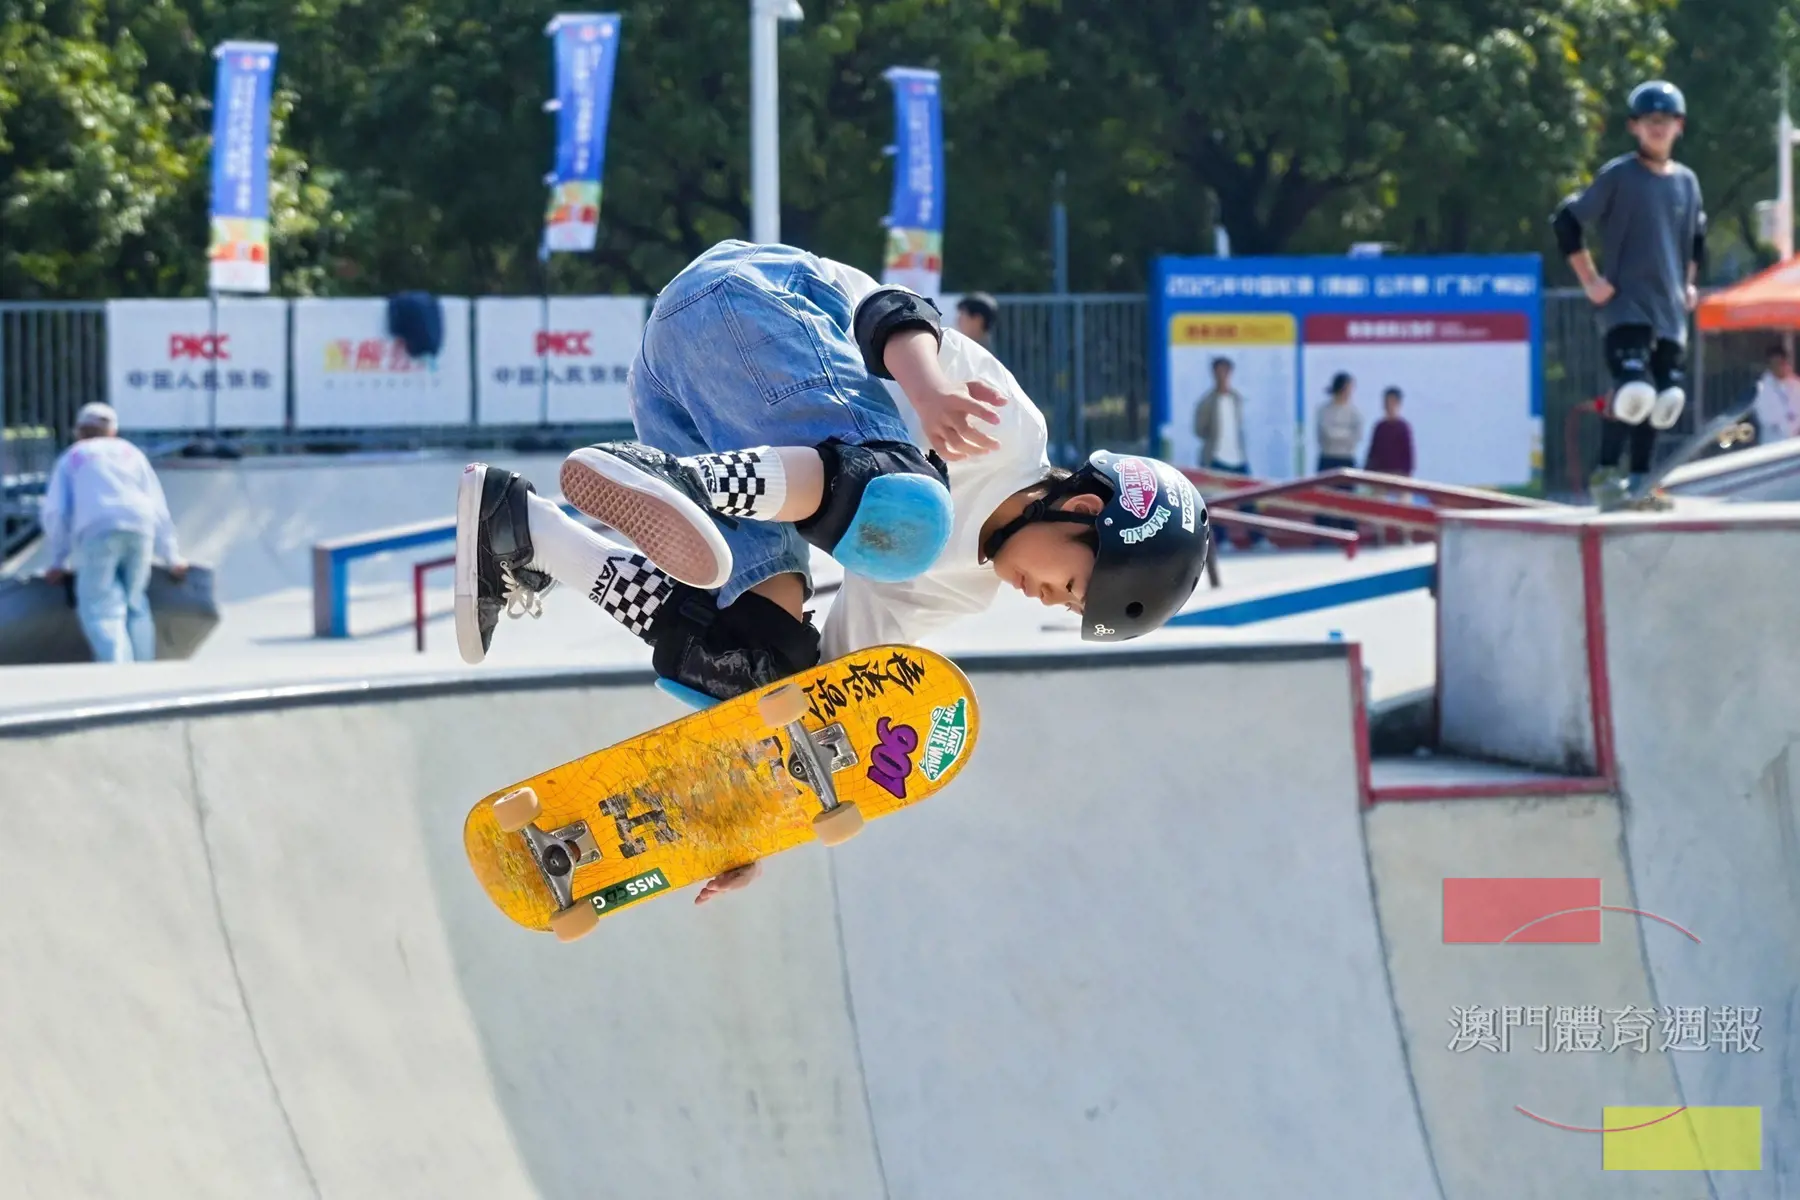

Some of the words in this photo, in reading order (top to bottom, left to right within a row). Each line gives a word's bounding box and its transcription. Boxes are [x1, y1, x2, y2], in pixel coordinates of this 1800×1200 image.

[1124, 471, 1141, 487] THE
[1125, 507, 1170, 542] MACAU
[588, 555, 626, 606] VANS
[932, 723, 951, 749] THE
[943, 725, 965, 757] VANS
[866, 716, 919, 799] 901
